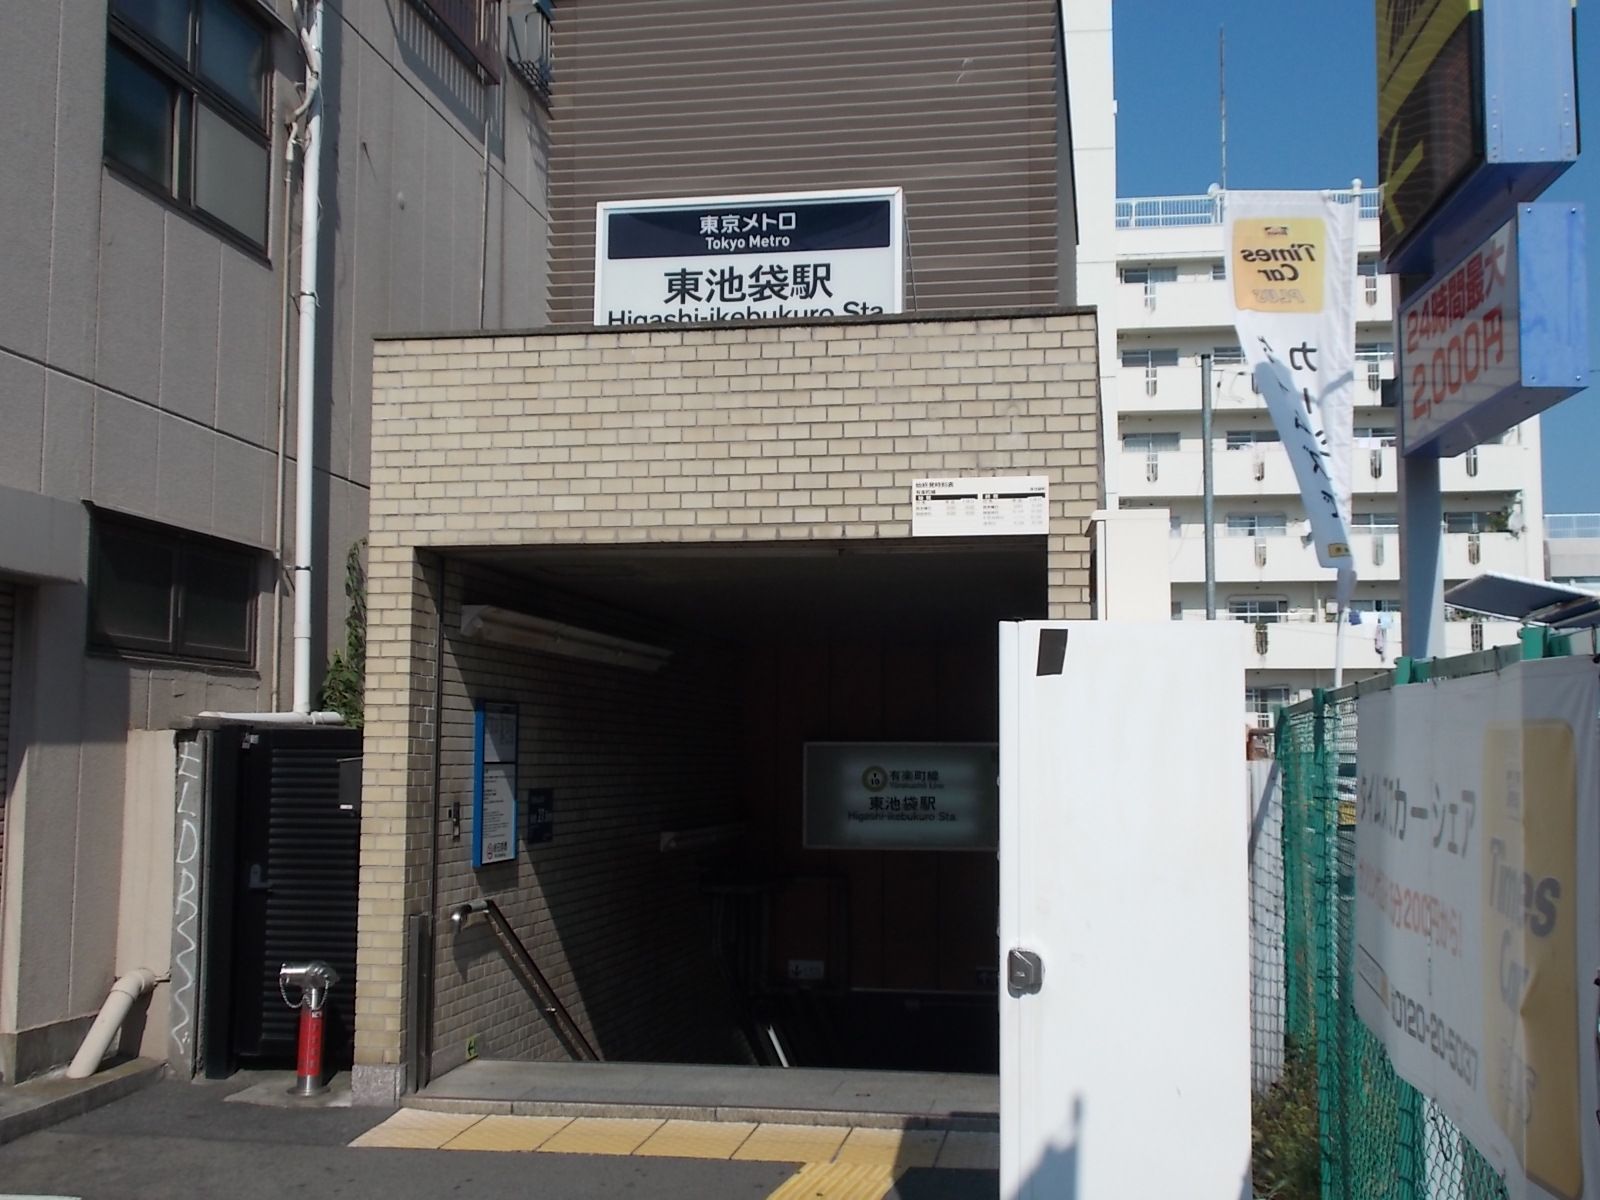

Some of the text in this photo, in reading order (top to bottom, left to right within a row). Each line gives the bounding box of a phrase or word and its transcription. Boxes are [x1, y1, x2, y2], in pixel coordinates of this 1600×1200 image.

[700, 212, 796, 234] 東京メトロ
[705, 234, 790, 250] Tokyo Metro
[663, 262, 833, 304] 東池袋駅
[1407, 244, 1507, 356] 24時間最大
[1411, 307, 1505, 420] 2,000円
[870, 796, 936, 811] 東池袋駅
